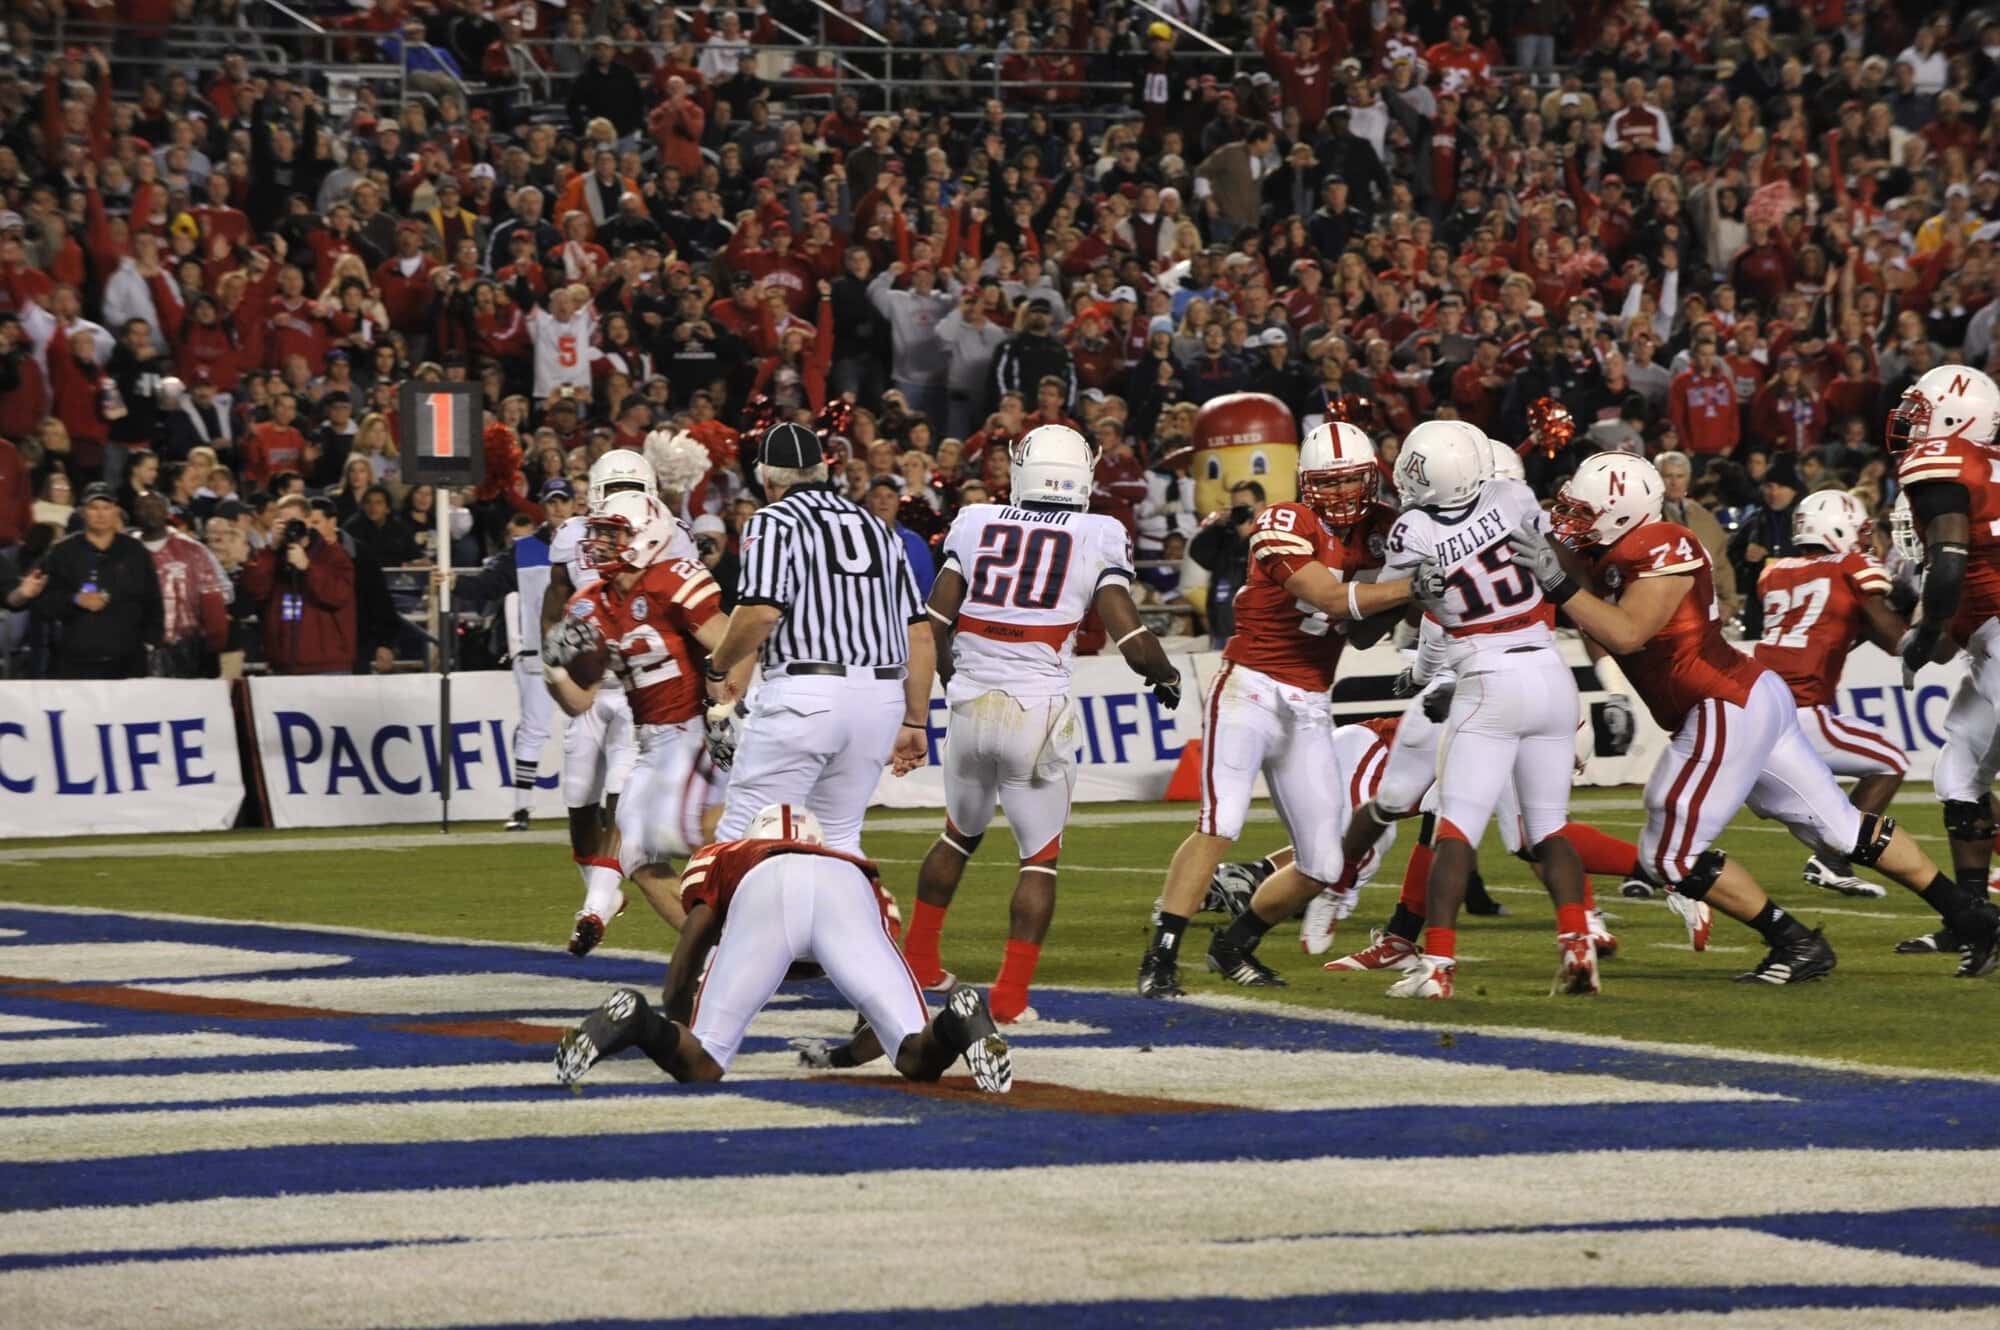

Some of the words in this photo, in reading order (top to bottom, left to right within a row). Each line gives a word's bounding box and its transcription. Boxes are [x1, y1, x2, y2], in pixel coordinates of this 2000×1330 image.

[558, 336, 577, 367] 5
[1949, 374, 1971, 396] N
[424, 393, 453, 457] 1
[1232, 431, 1263, 444] RED
[1609, 471, 1626, 496] N
[819, 510, 872, 574] U
[1256, 508, 1296, 533] 49
[968, 523, 1073, 609] 20
[1443, 533, 1535, 622] 15
[1649, 537, 1694, 570] 74
[1762, 577, 1831, 648] 27
[43, 709, 216, 795] LIFE
